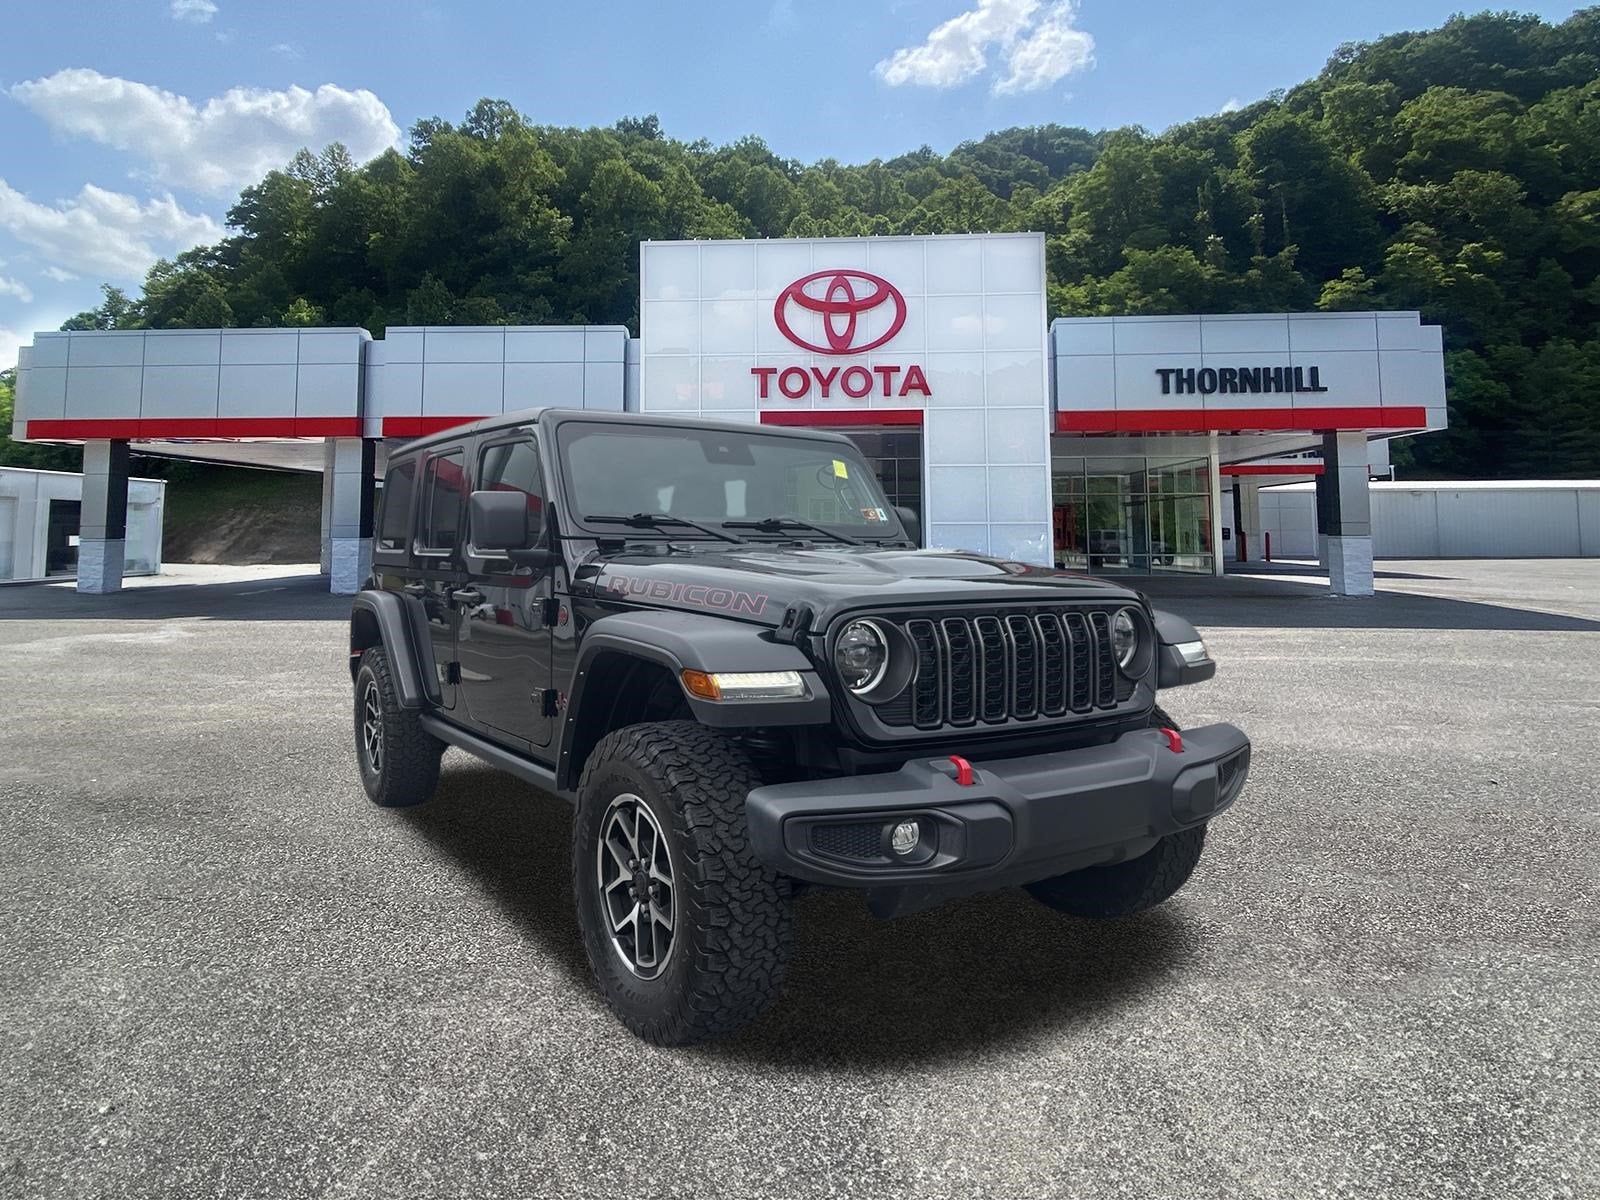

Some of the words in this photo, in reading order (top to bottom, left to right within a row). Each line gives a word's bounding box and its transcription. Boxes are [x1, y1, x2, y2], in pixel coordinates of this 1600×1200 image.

[751, 365, 932, 399] TOYOTA
[1156, 366, 1328, 394] THORNHILL
[607, 575, 768, 616] RUBICON
